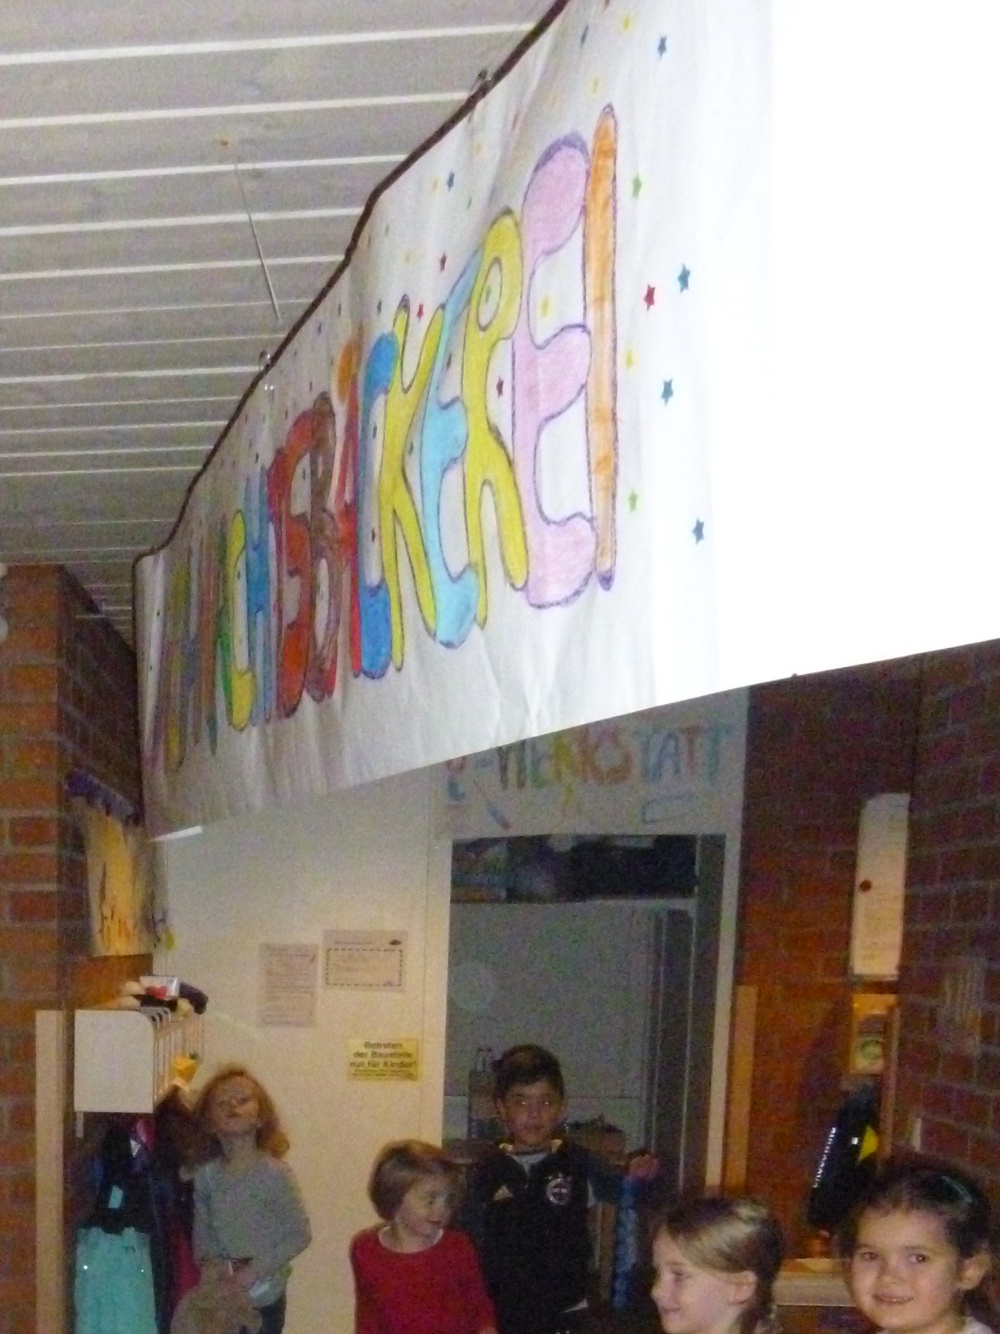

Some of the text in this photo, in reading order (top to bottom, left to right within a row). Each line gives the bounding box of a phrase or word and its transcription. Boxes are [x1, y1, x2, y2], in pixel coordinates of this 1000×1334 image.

[363, 1041, 403, 1049] Betreten
[353, 1051, 413, 1059] der Baustelle
[368, 1060, 380, 1068] für
